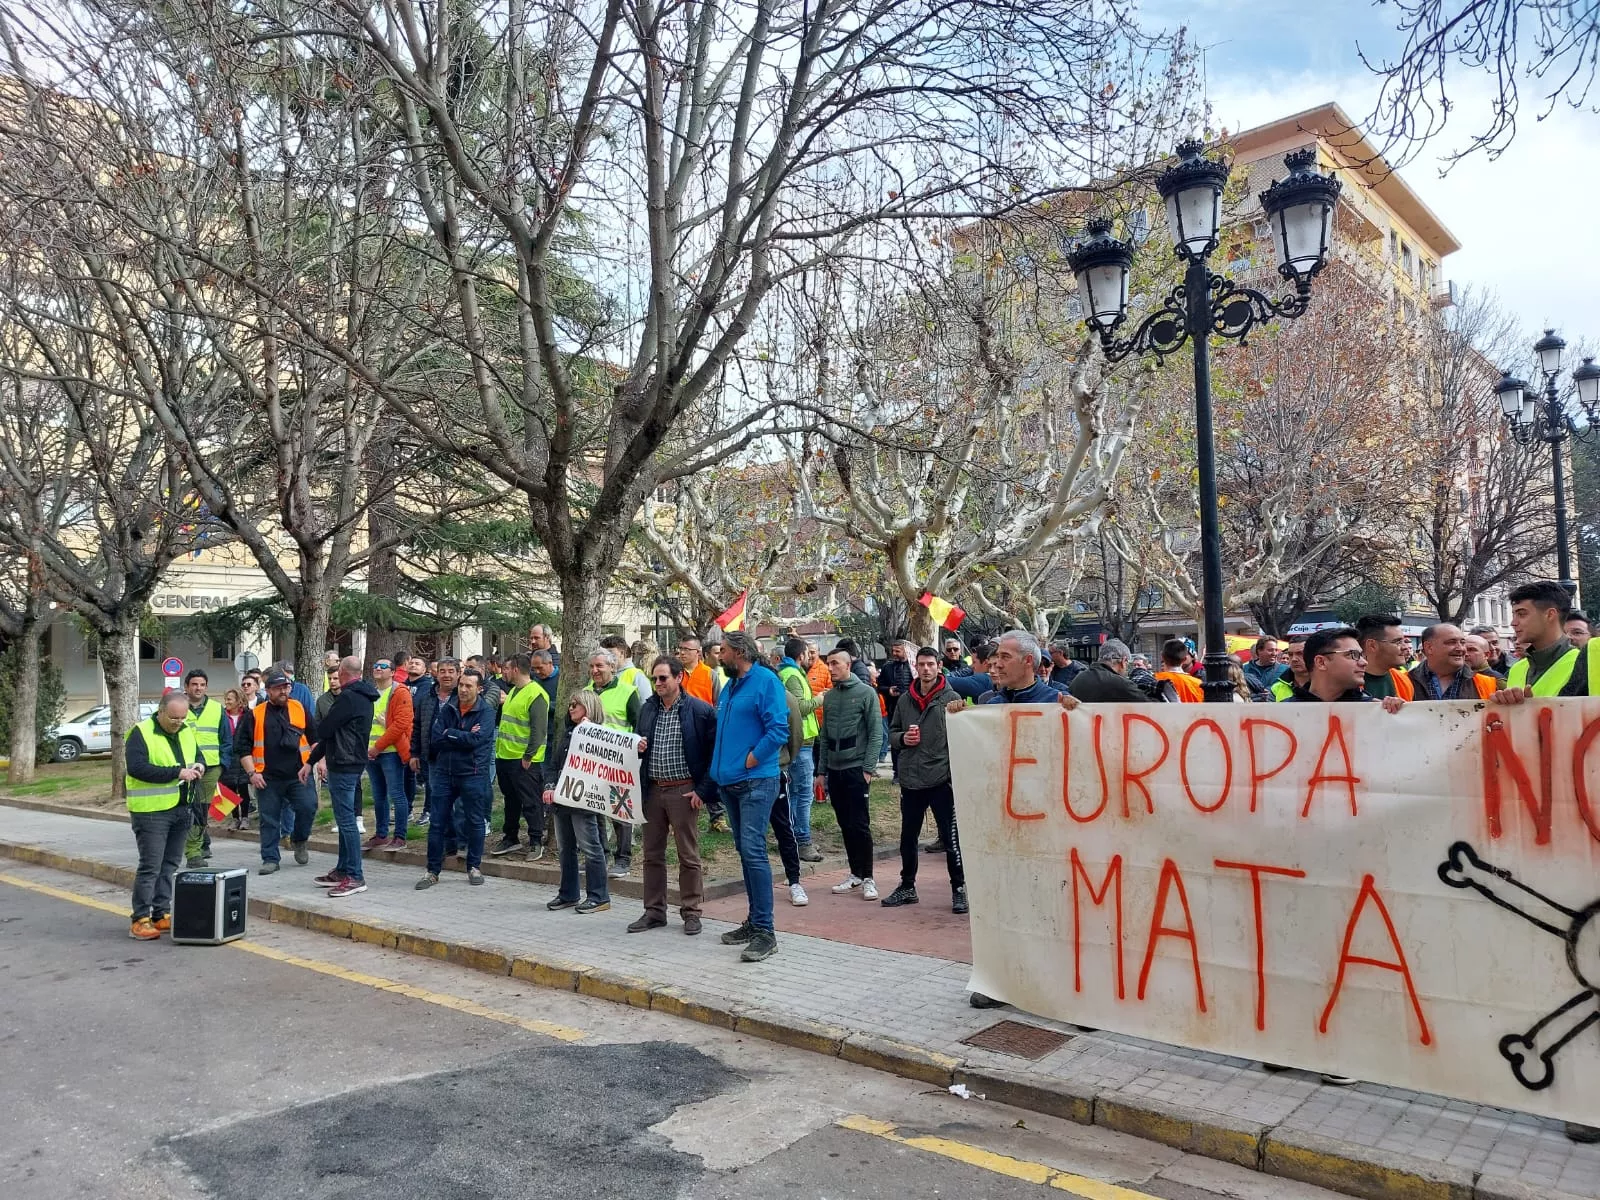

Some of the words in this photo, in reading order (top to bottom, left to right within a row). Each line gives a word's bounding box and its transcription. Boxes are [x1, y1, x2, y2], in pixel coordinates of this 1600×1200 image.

[586, 727, 633, 750] AGRICULTURA
[569, 754, 580, 769] NO
[581, 758, 597, 776] HAY
[598, 764, 635, 786] COMIDA
[1006, 711, 1360, 822] EUROPA
[560, 776, 585, 802] NO
[584, 791, 606, 802] AGENDA
[586, 799, 606, 811] 2030
[1072, 848, 1434, 1045] MATA
